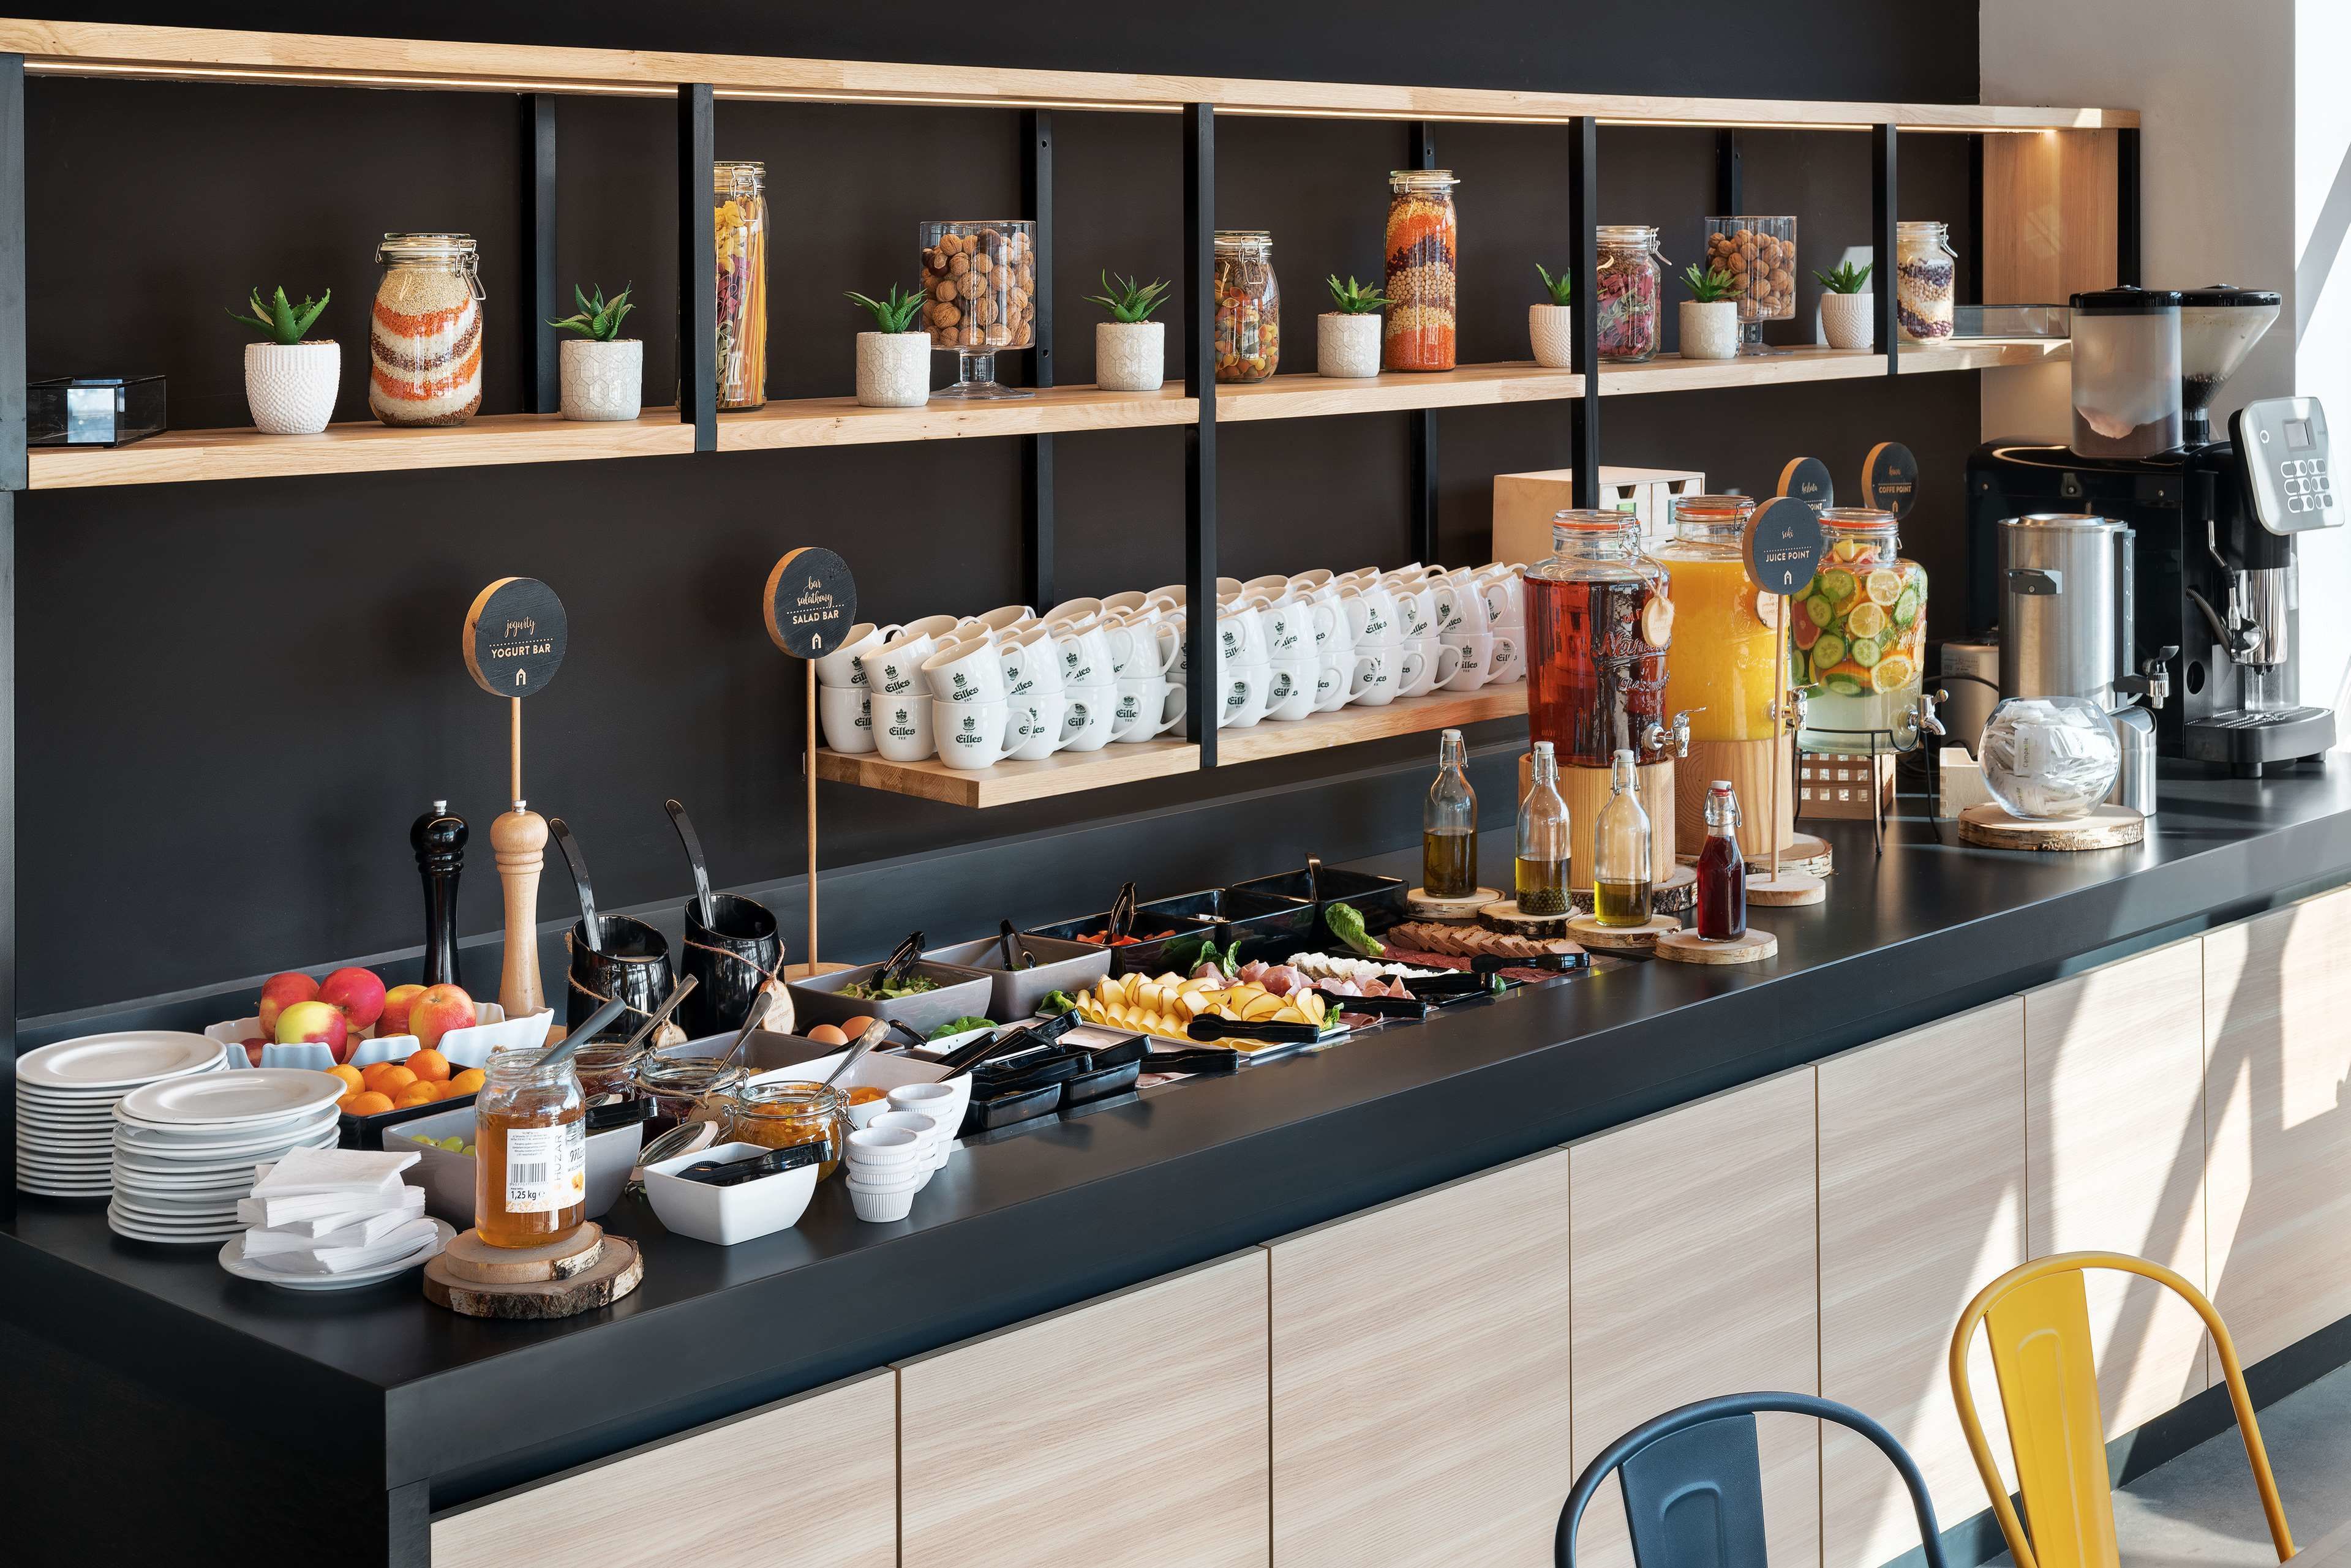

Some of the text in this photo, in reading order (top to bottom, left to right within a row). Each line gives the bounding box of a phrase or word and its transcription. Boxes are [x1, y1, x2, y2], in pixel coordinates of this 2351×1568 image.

[1896, 485, 1911, 493] POINT
[1766, 550, 1810, 563] JUICE POINT
[803, 576, 822, 593] bar
[792, 609, 840, 625] SALAD BAR
[504, 615, 536, 638] jogurty
[491, 643, 551, 659] YOGURT BAR
[851, 672, 868, 685] Eill
[885, 679, 911, 692] Eilles
[952, 686, 979, 700] Eilles
[1116, 709, 1138, 718] Eille
[889, 726, 916, 736] Eilles
[955, 733, 983, 744] Eilles
[511, 1190, 536, 1201] 1,25 kg
